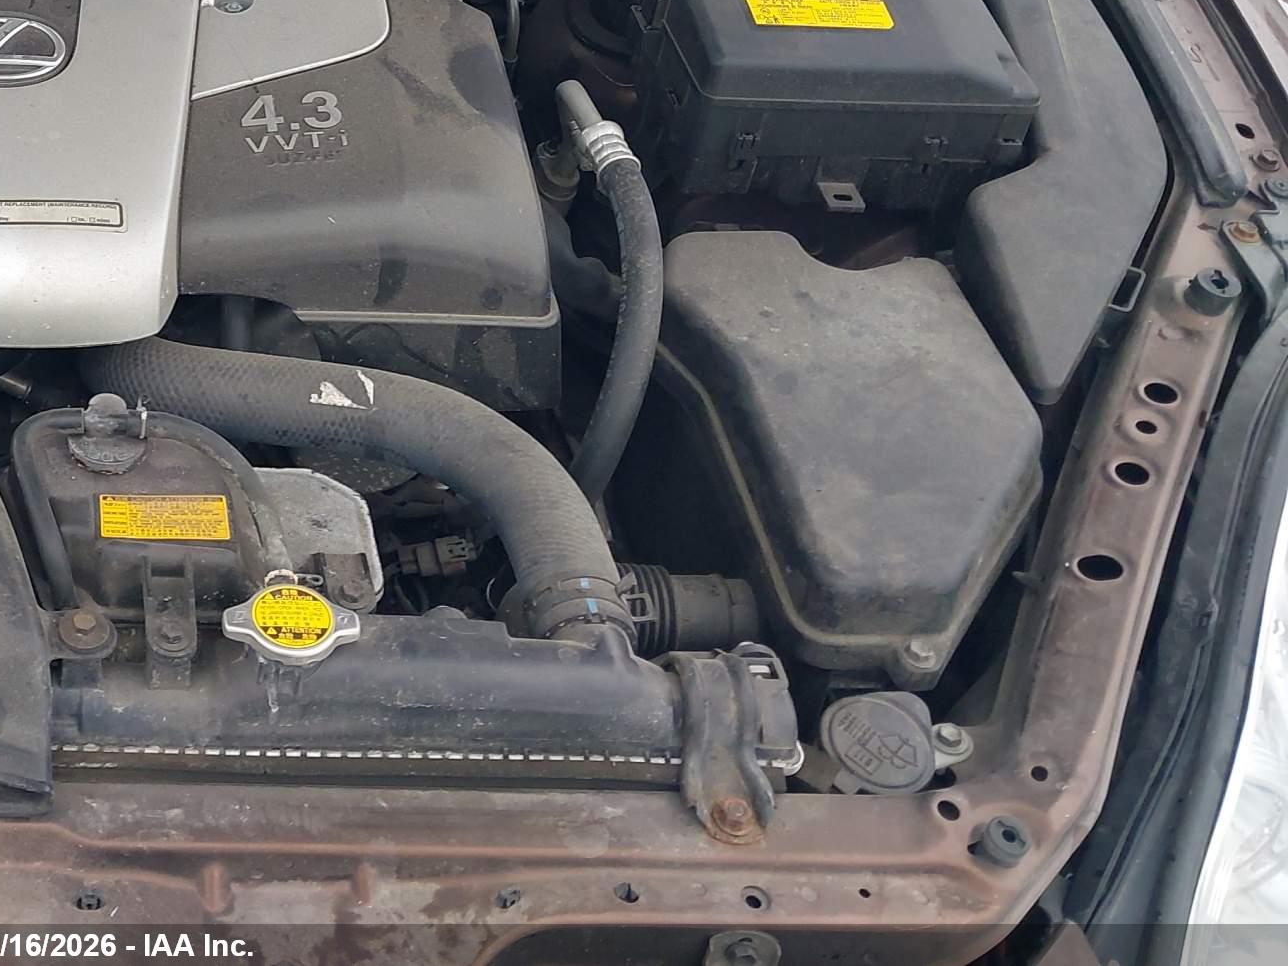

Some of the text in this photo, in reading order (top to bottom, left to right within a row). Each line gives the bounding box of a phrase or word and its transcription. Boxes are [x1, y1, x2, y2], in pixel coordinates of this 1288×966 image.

[240, 90, 342, 133] 4.3
[244, 129, 349, 154] VVT-i
[281, 627, 322, 635] ATTENTION
